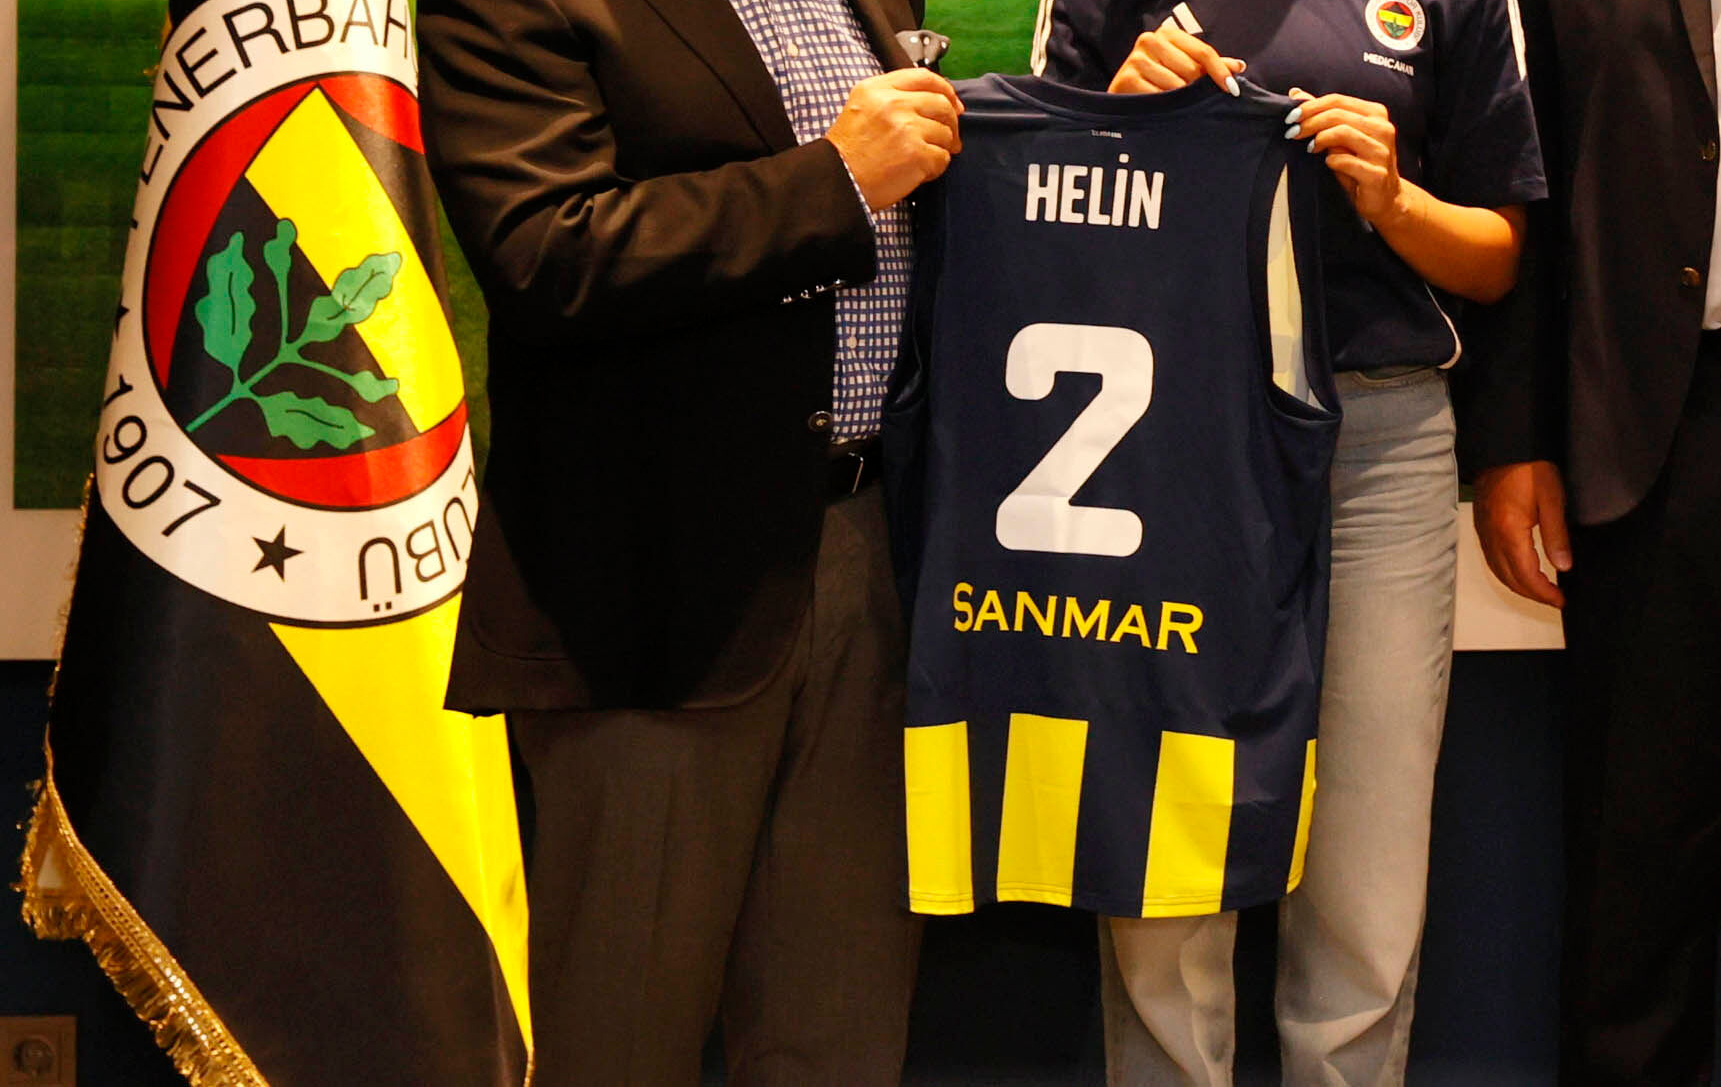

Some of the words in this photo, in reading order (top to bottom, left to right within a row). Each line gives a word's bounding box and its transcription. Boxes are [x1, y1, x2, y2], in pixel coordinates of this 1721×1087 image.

[1026, 154, 1164, 229] HELİN
[102, 374, 221, 537] 1907
[996, 323, 1153, 557] 2
[953, 583, 1204, 654] SANMAR
